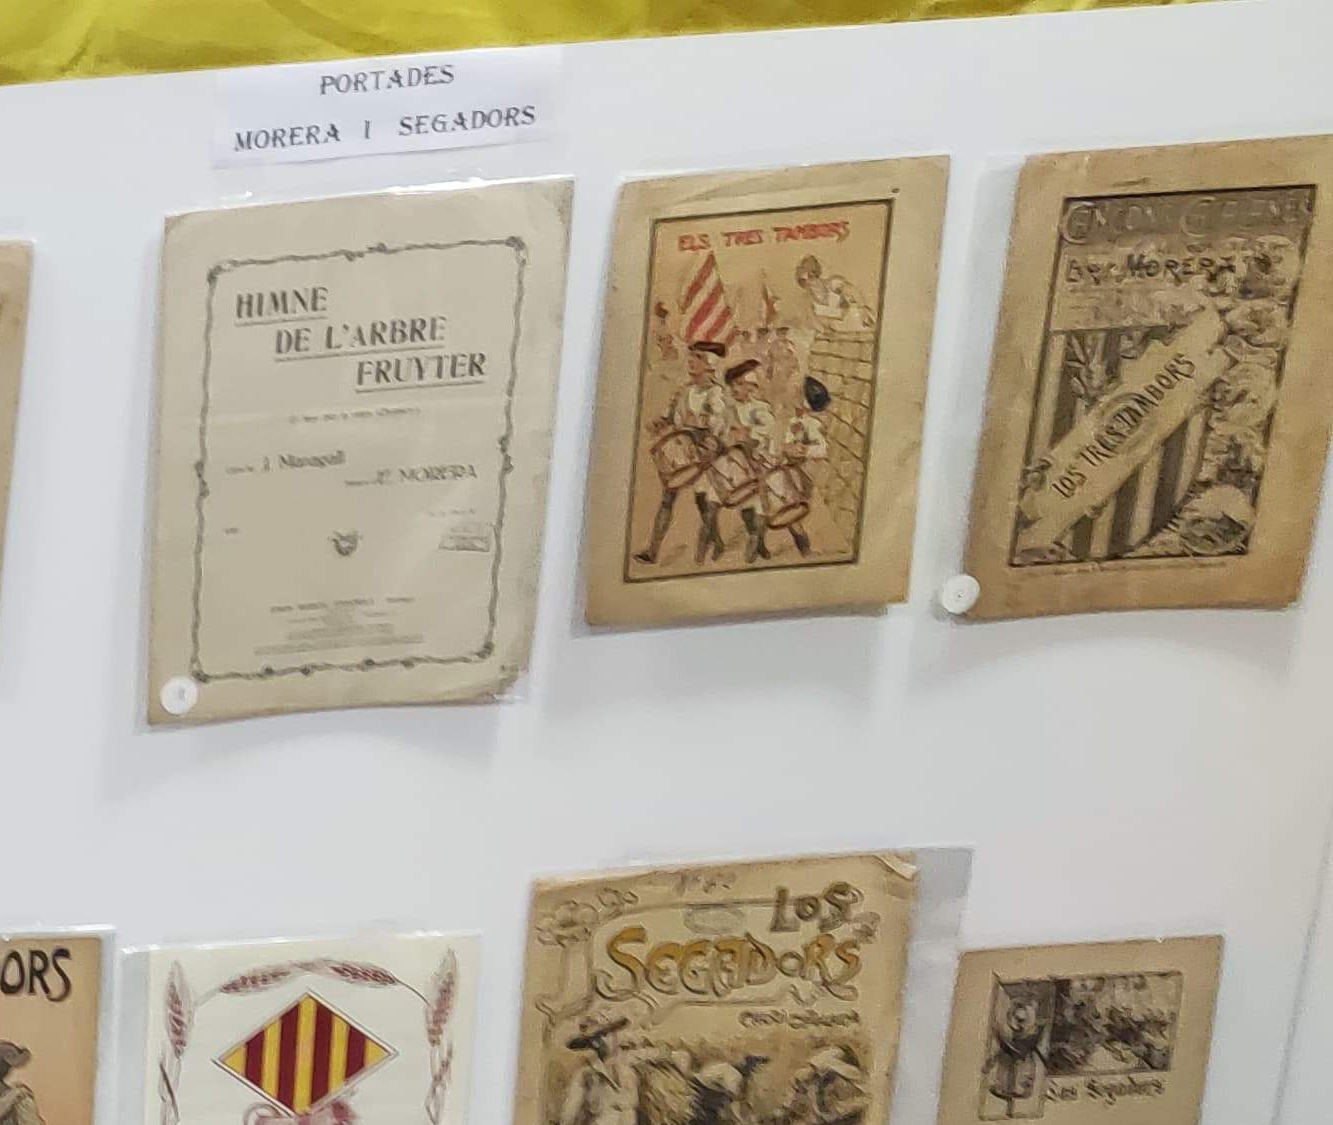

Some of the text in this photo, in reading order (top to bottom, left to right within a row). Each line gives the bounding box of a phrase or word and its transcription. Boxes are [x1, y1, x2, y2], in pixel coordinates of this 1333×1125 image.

[319, 64, 455, 96] PORTADES
[234, 104, 536, 152] MORERA I SEGADORS
[235, 285, 329, 320] HIMNE
[274, 315, 448, 356] DE L'ARBRE
[356, 351, 488, 386] FRUYTER
